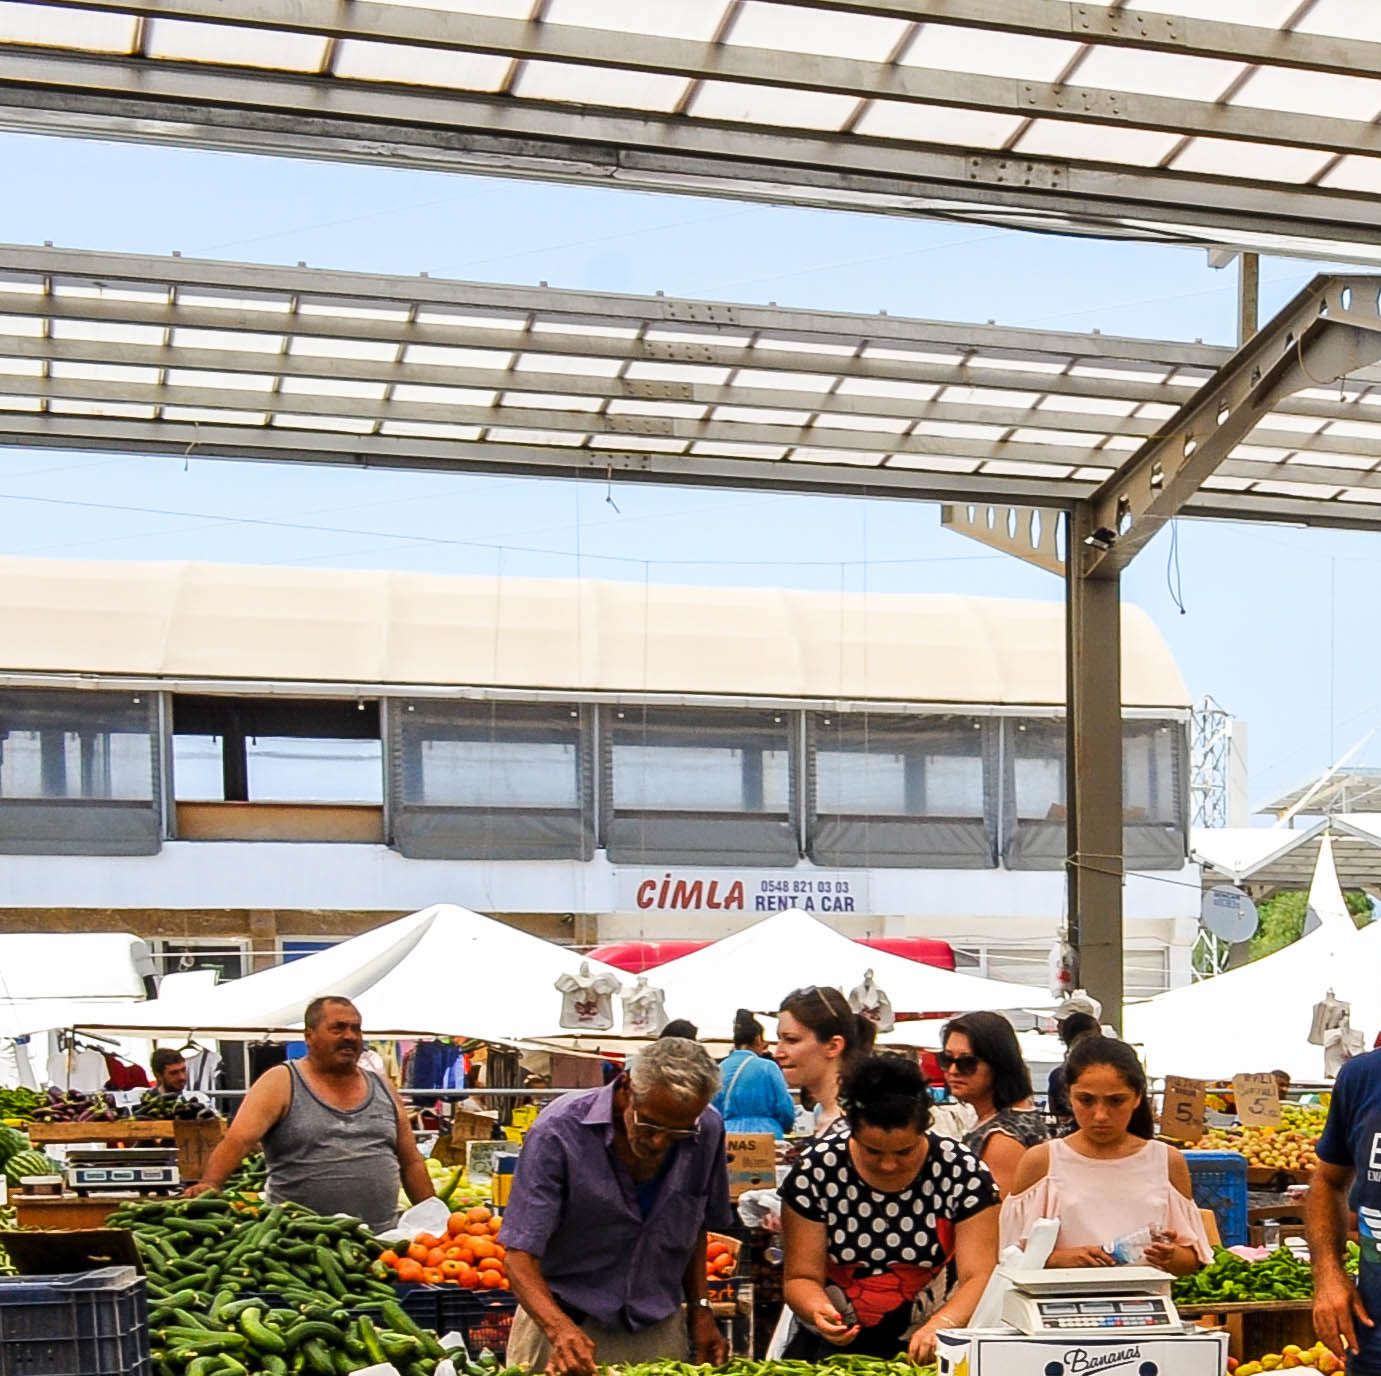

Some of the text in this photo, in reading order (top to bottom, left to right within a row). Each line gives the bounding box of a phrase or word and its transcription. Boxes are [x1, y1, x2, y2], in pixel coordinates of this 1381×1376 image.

[761, 880, 849, 893] 0548 821 03 03
[755, 895, 855, 912] RENT A CAR
[1064, 1345, 1142, 1374] Bananas
